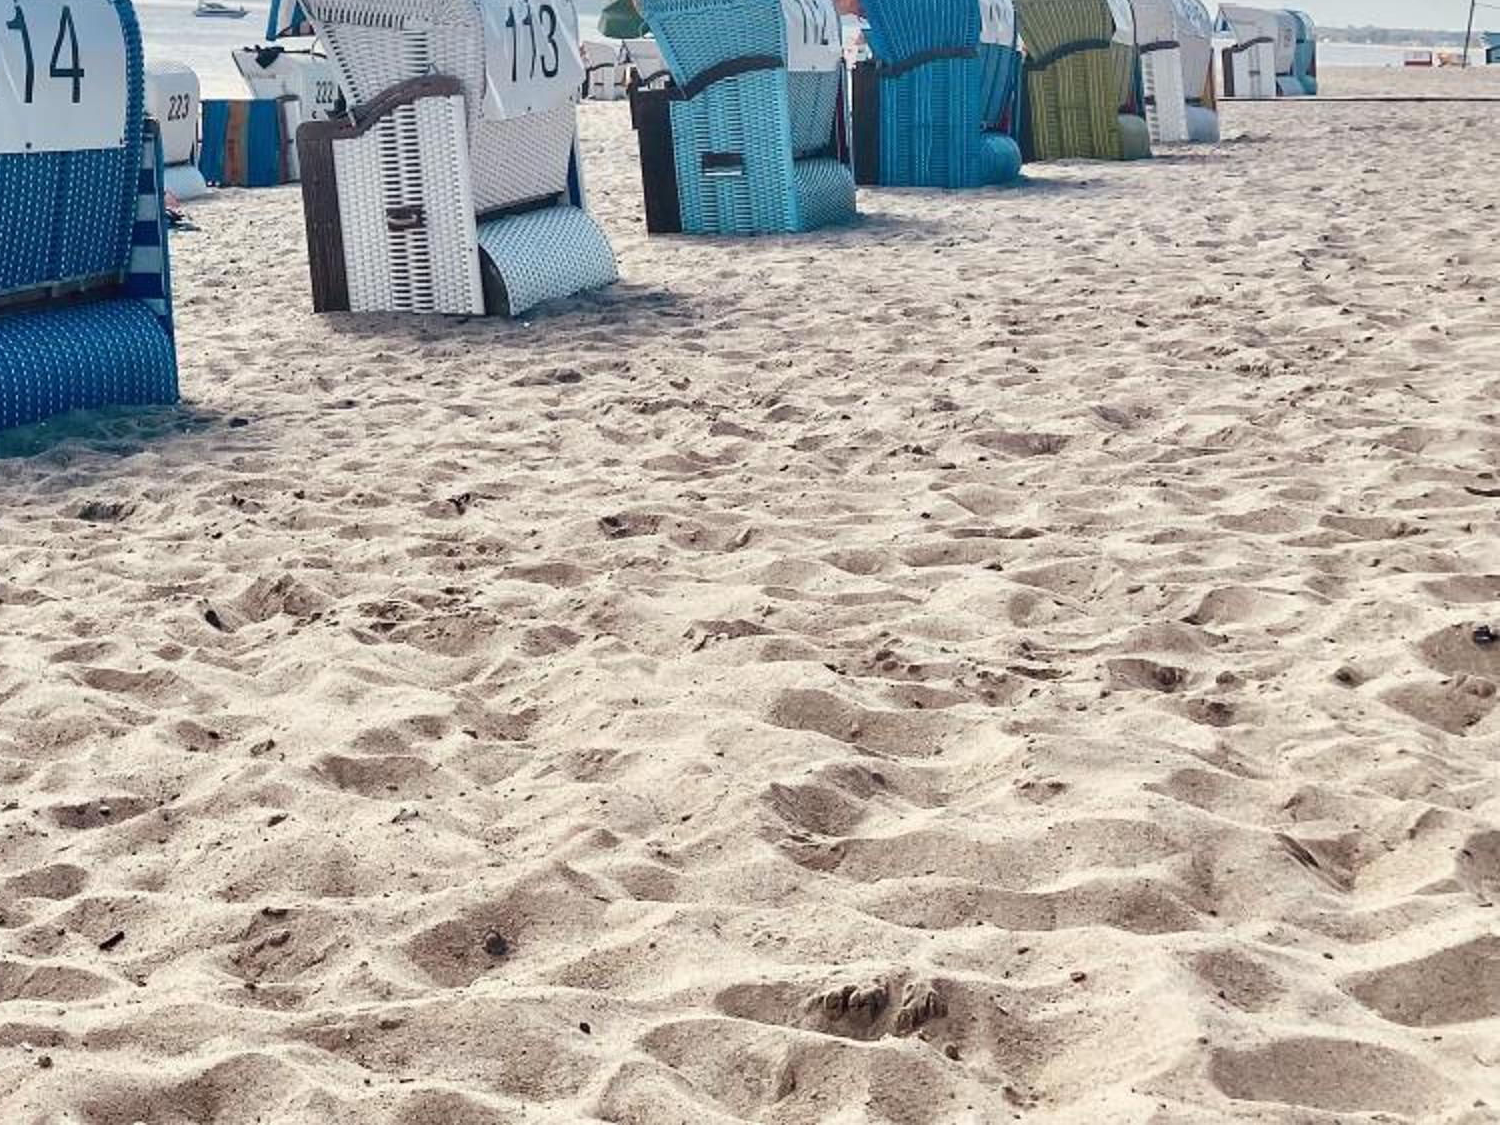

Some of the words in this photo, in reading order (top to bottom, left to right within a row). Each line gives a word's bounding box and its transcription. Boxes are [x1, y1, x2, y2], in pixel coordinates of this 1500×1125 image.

[505, 5, 559, 82] 113
[315, 80, 333, 104] 222
[167, 93, 190, 121] 223
